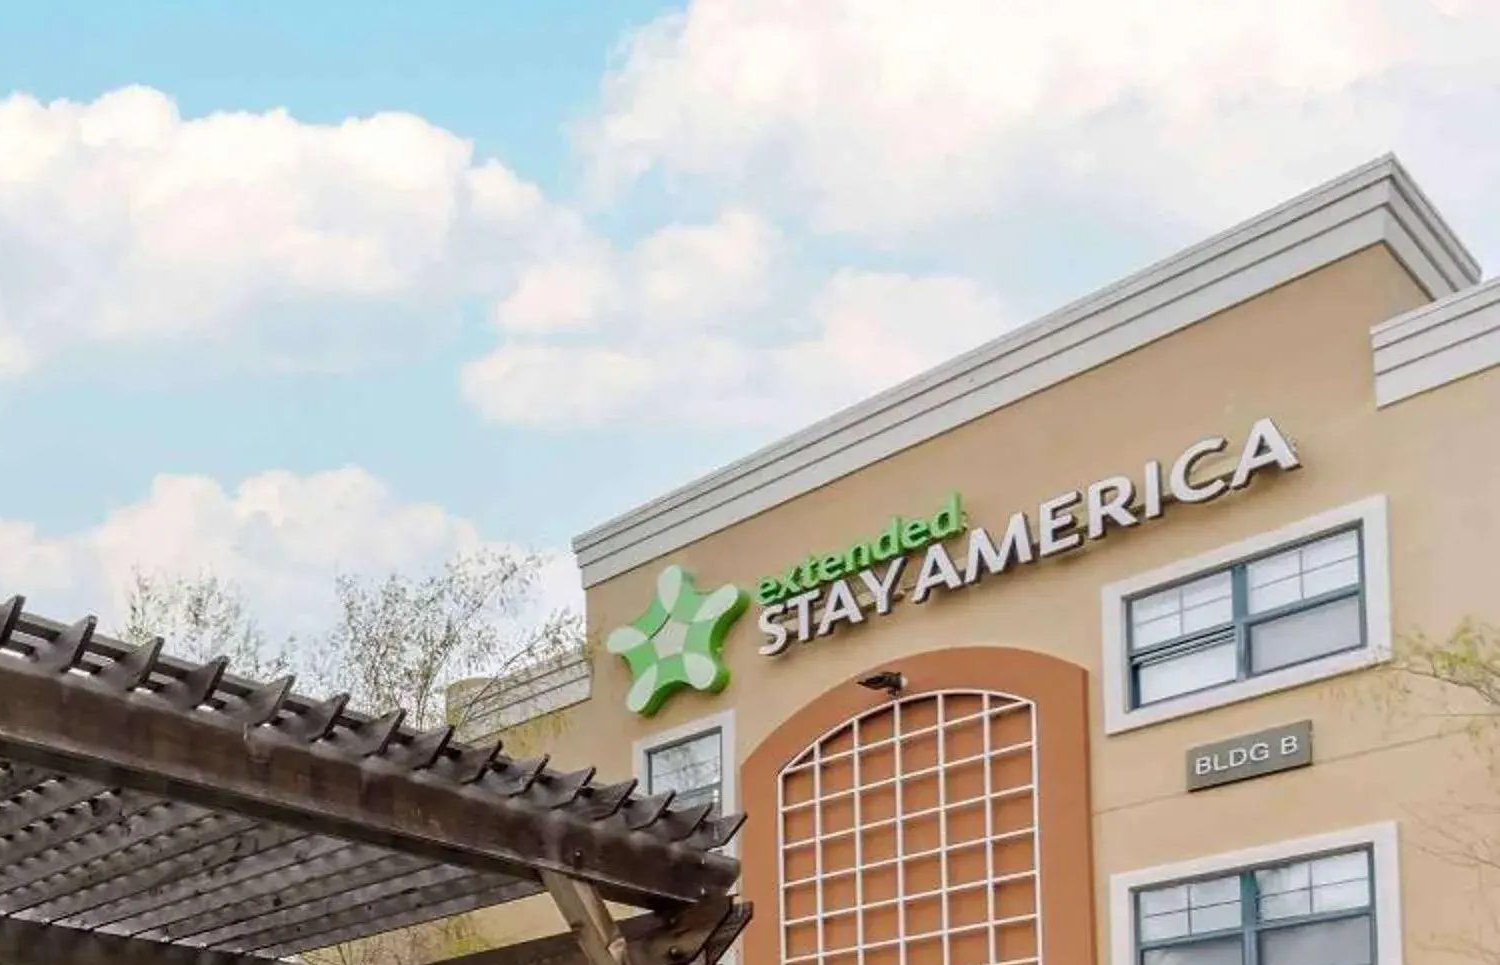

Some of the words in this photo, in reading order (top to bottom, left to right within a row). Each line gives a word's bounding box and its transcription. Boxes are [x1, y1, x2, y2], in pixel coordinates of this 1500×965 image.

[758, 491, 963, 605] extended
[1195, 742, 1269, 775] BLDG
[1280, 735, 1298, 755] B
